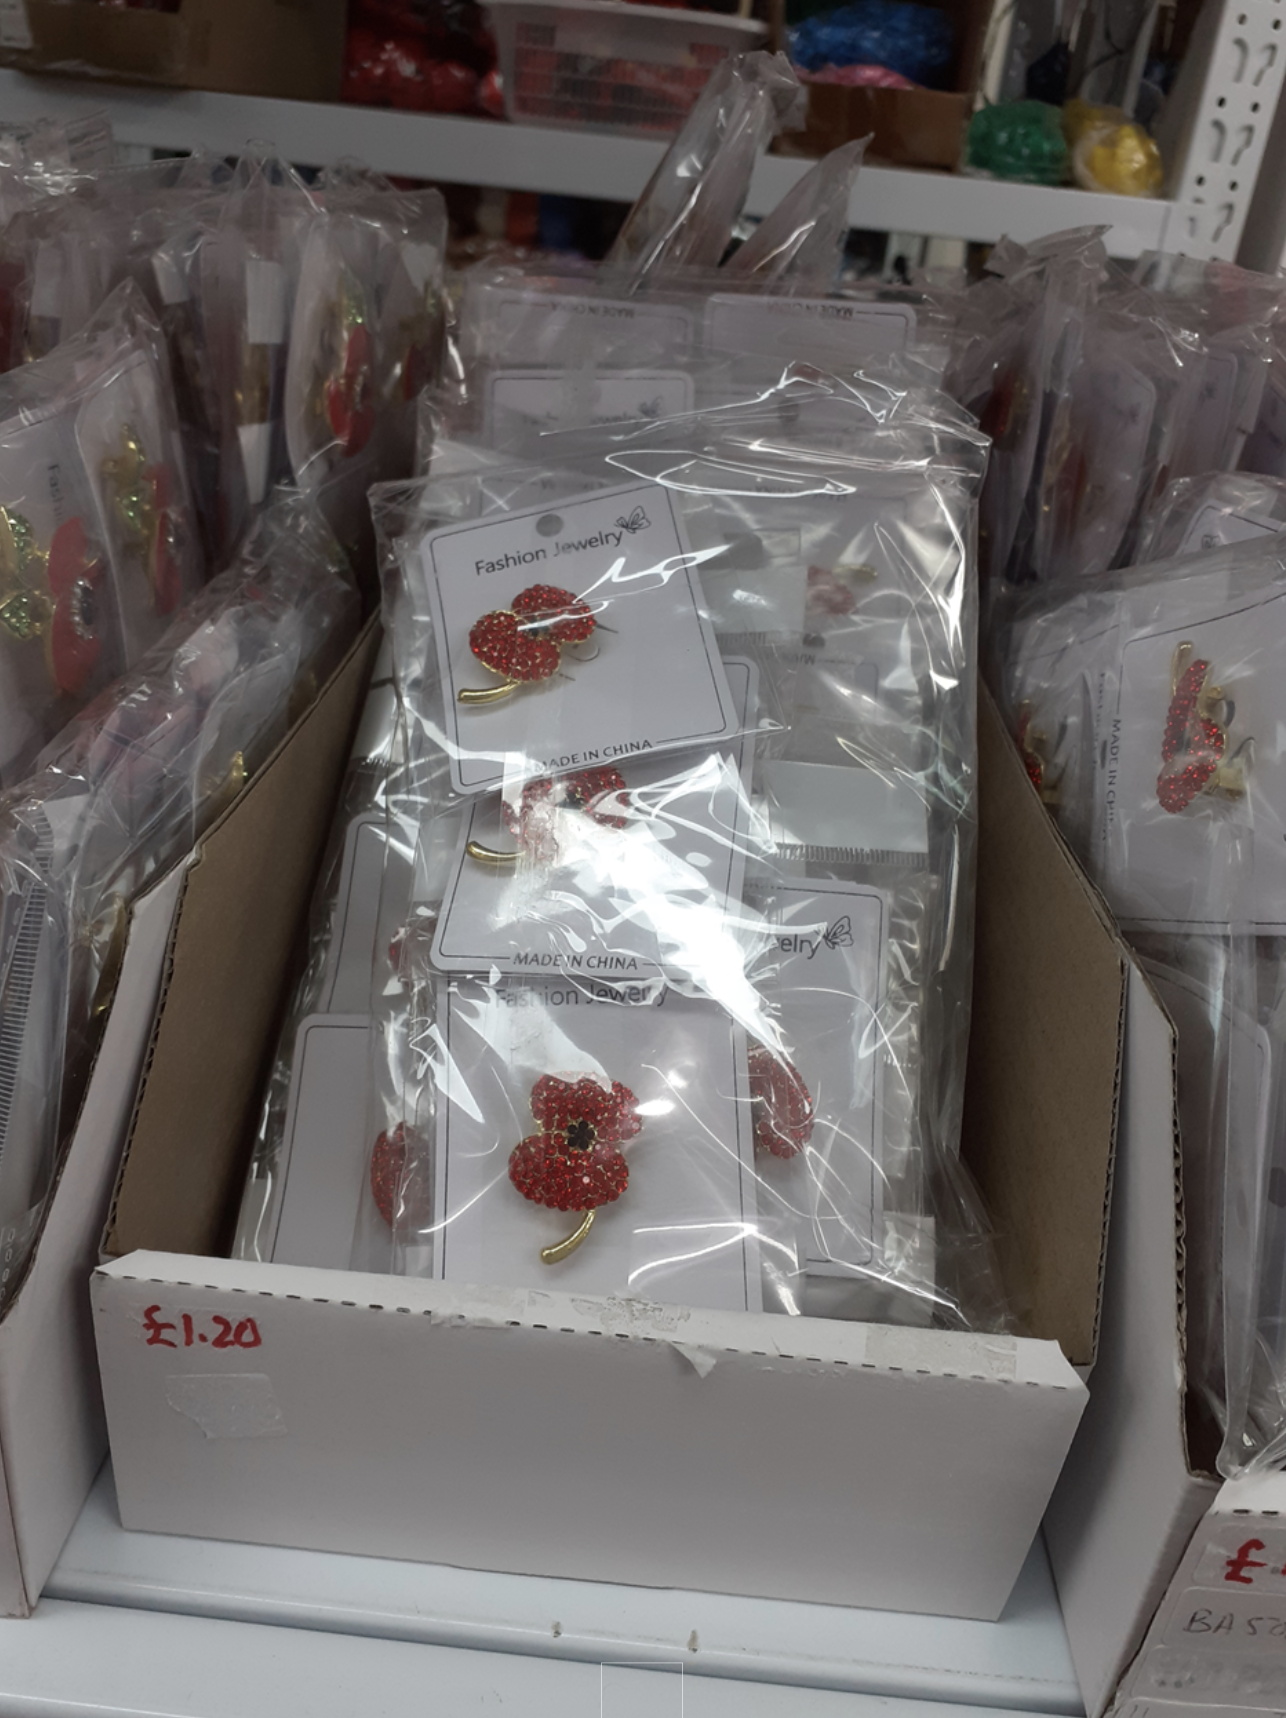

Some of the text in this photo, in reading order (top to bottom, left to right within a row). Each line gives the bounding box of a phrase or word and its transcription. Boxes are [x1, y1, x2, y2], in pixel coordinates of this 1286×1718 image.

[474, 530, 624, 577] Fashion Jewelry
[534, 738, 654, 774] MADE IN CHINA
[1108, 718, 1122, 766] MADE
[1107, 769, 1118, 787] IN
[512, 952, 639, 971] MADE IN CHINA
[142, 1303, 263, 1349] £1.20
